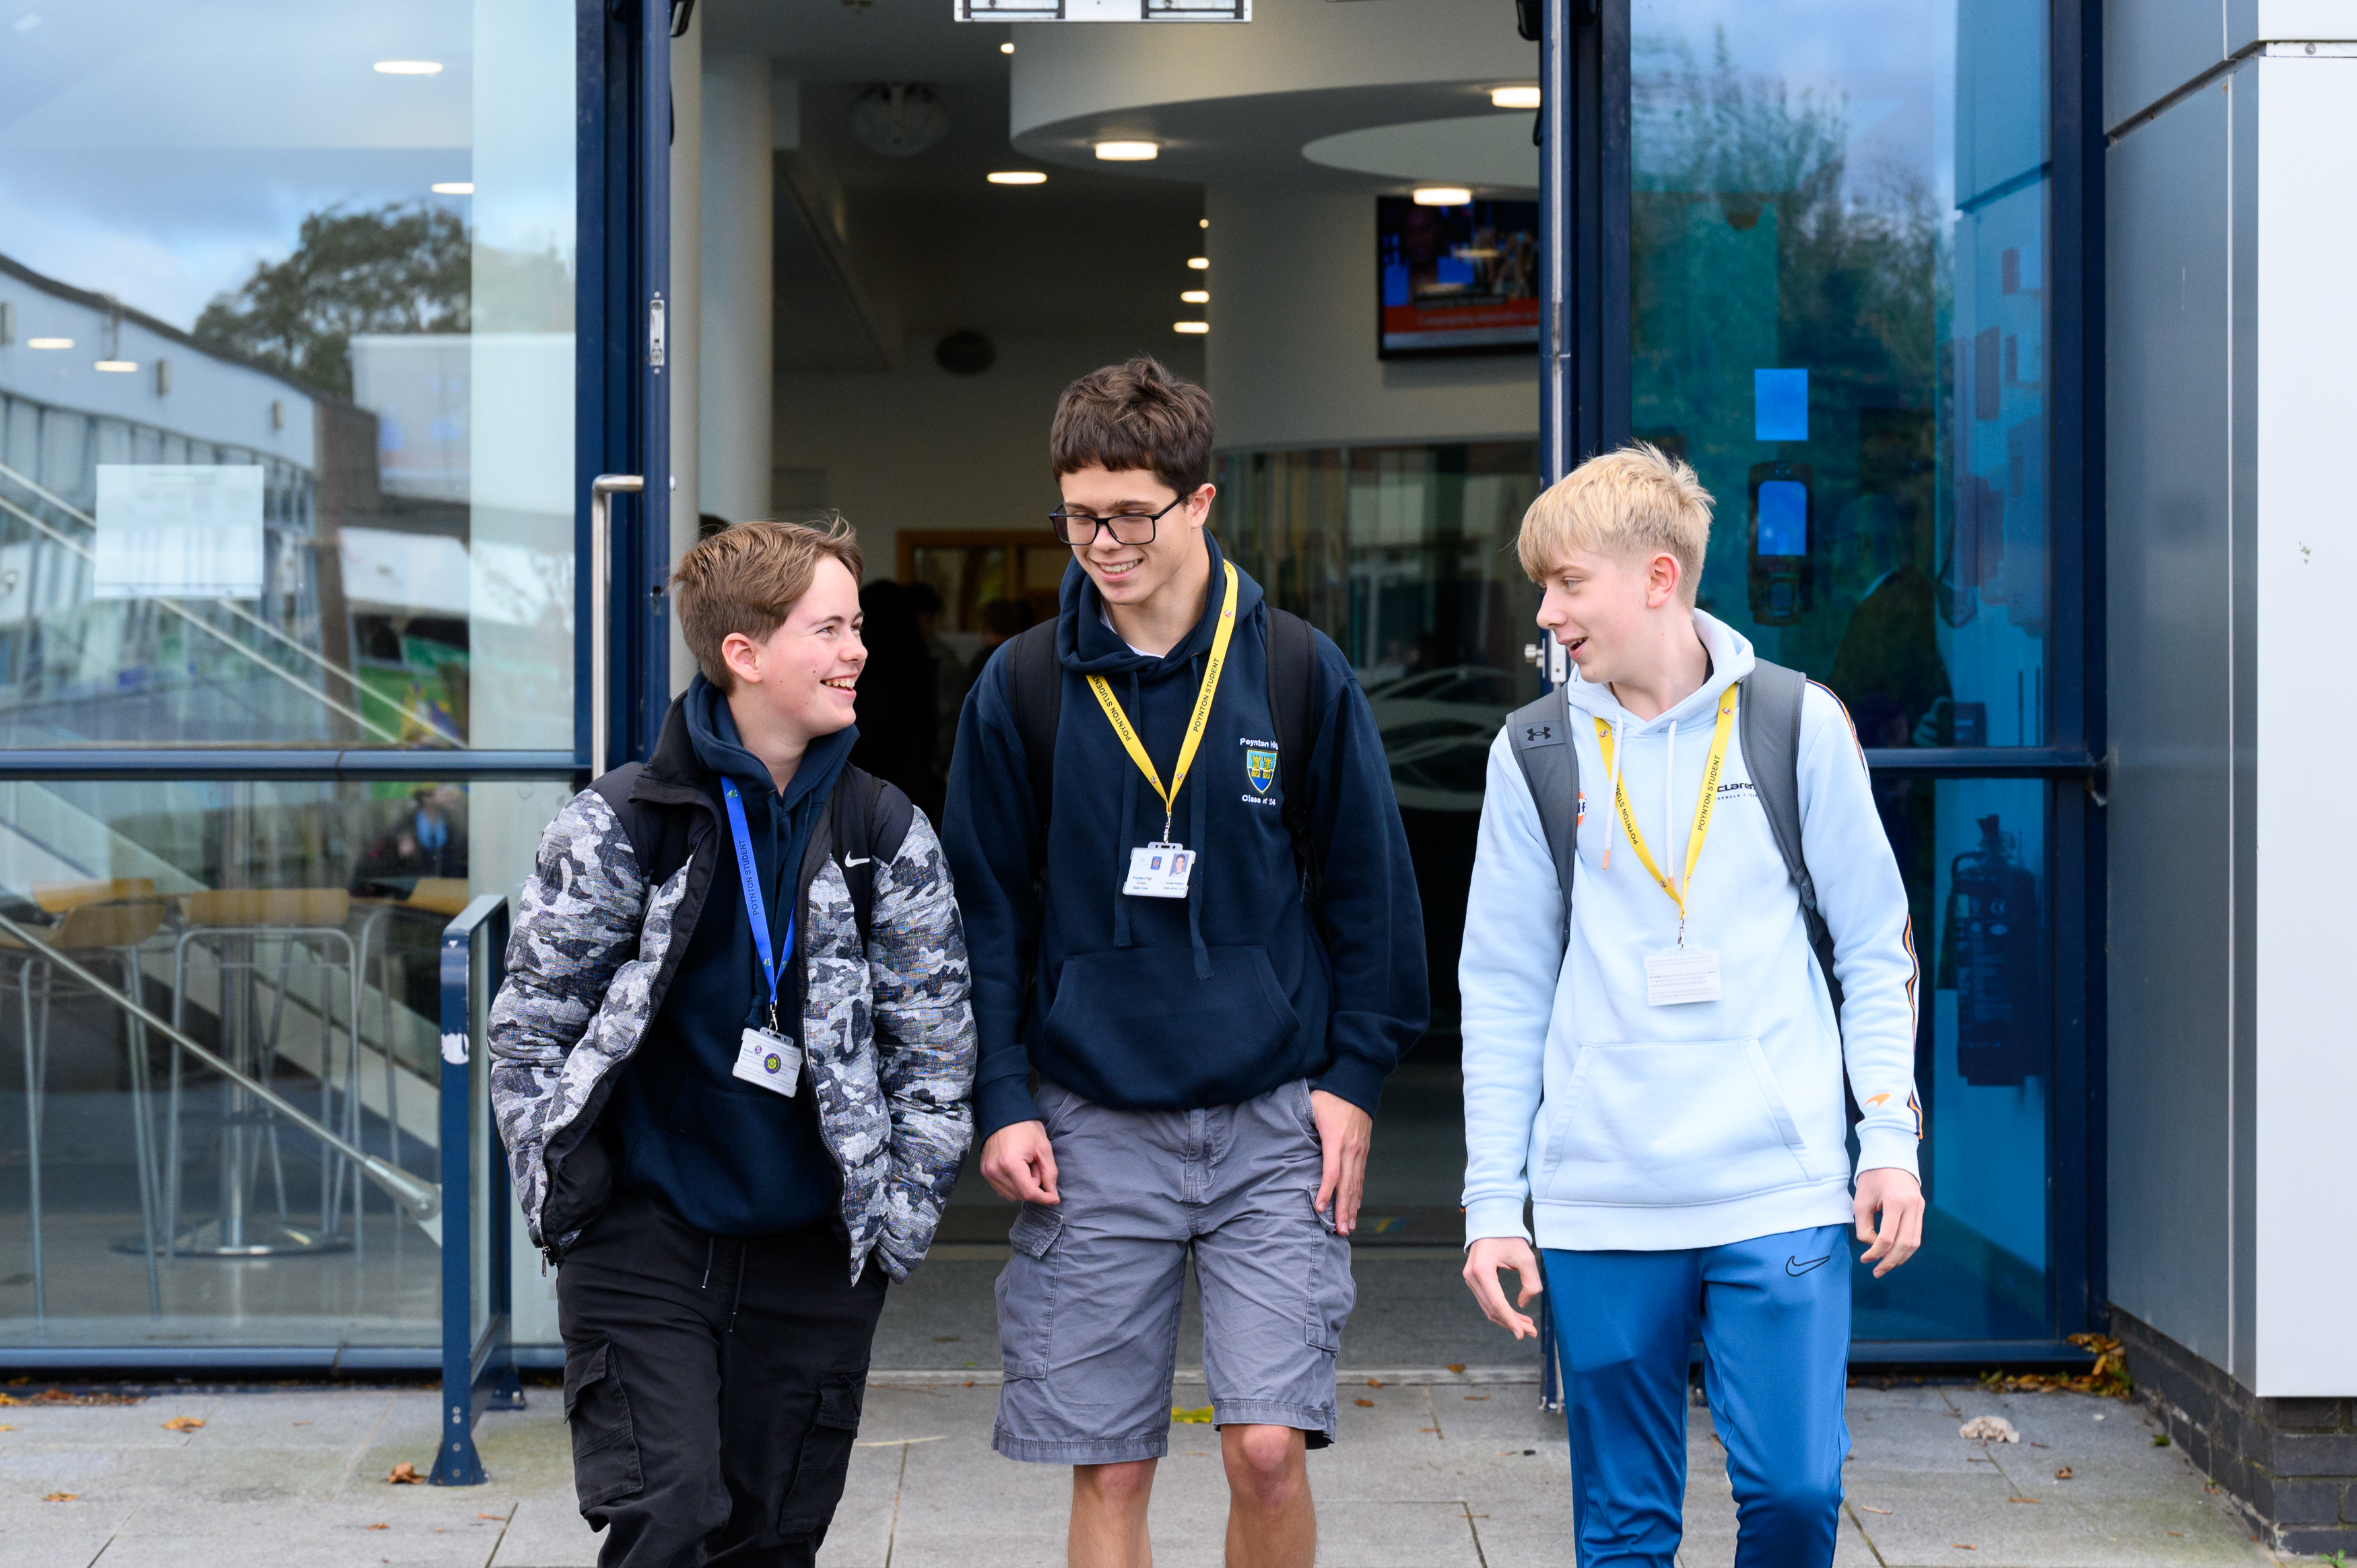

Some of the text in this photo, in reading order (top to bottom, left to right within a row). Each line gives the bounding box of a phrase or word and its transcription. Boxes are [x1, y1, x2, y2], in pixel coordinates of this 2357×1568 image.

[1092, 675, 1131, 741] POYNTON STUDENT
[1193, 657, 1220, 732] POYNTON STUDENT
[1240, 738, 1278, 751] Poynton Hig
[1242, 794, 1261, 803] Class
[1616, 783, 1638, 845] POYNTON STUD
[1698, 755, 1721, 831] POYNTON STUDENT
[738, 840, 759, 916] POYNTON STUDENT
